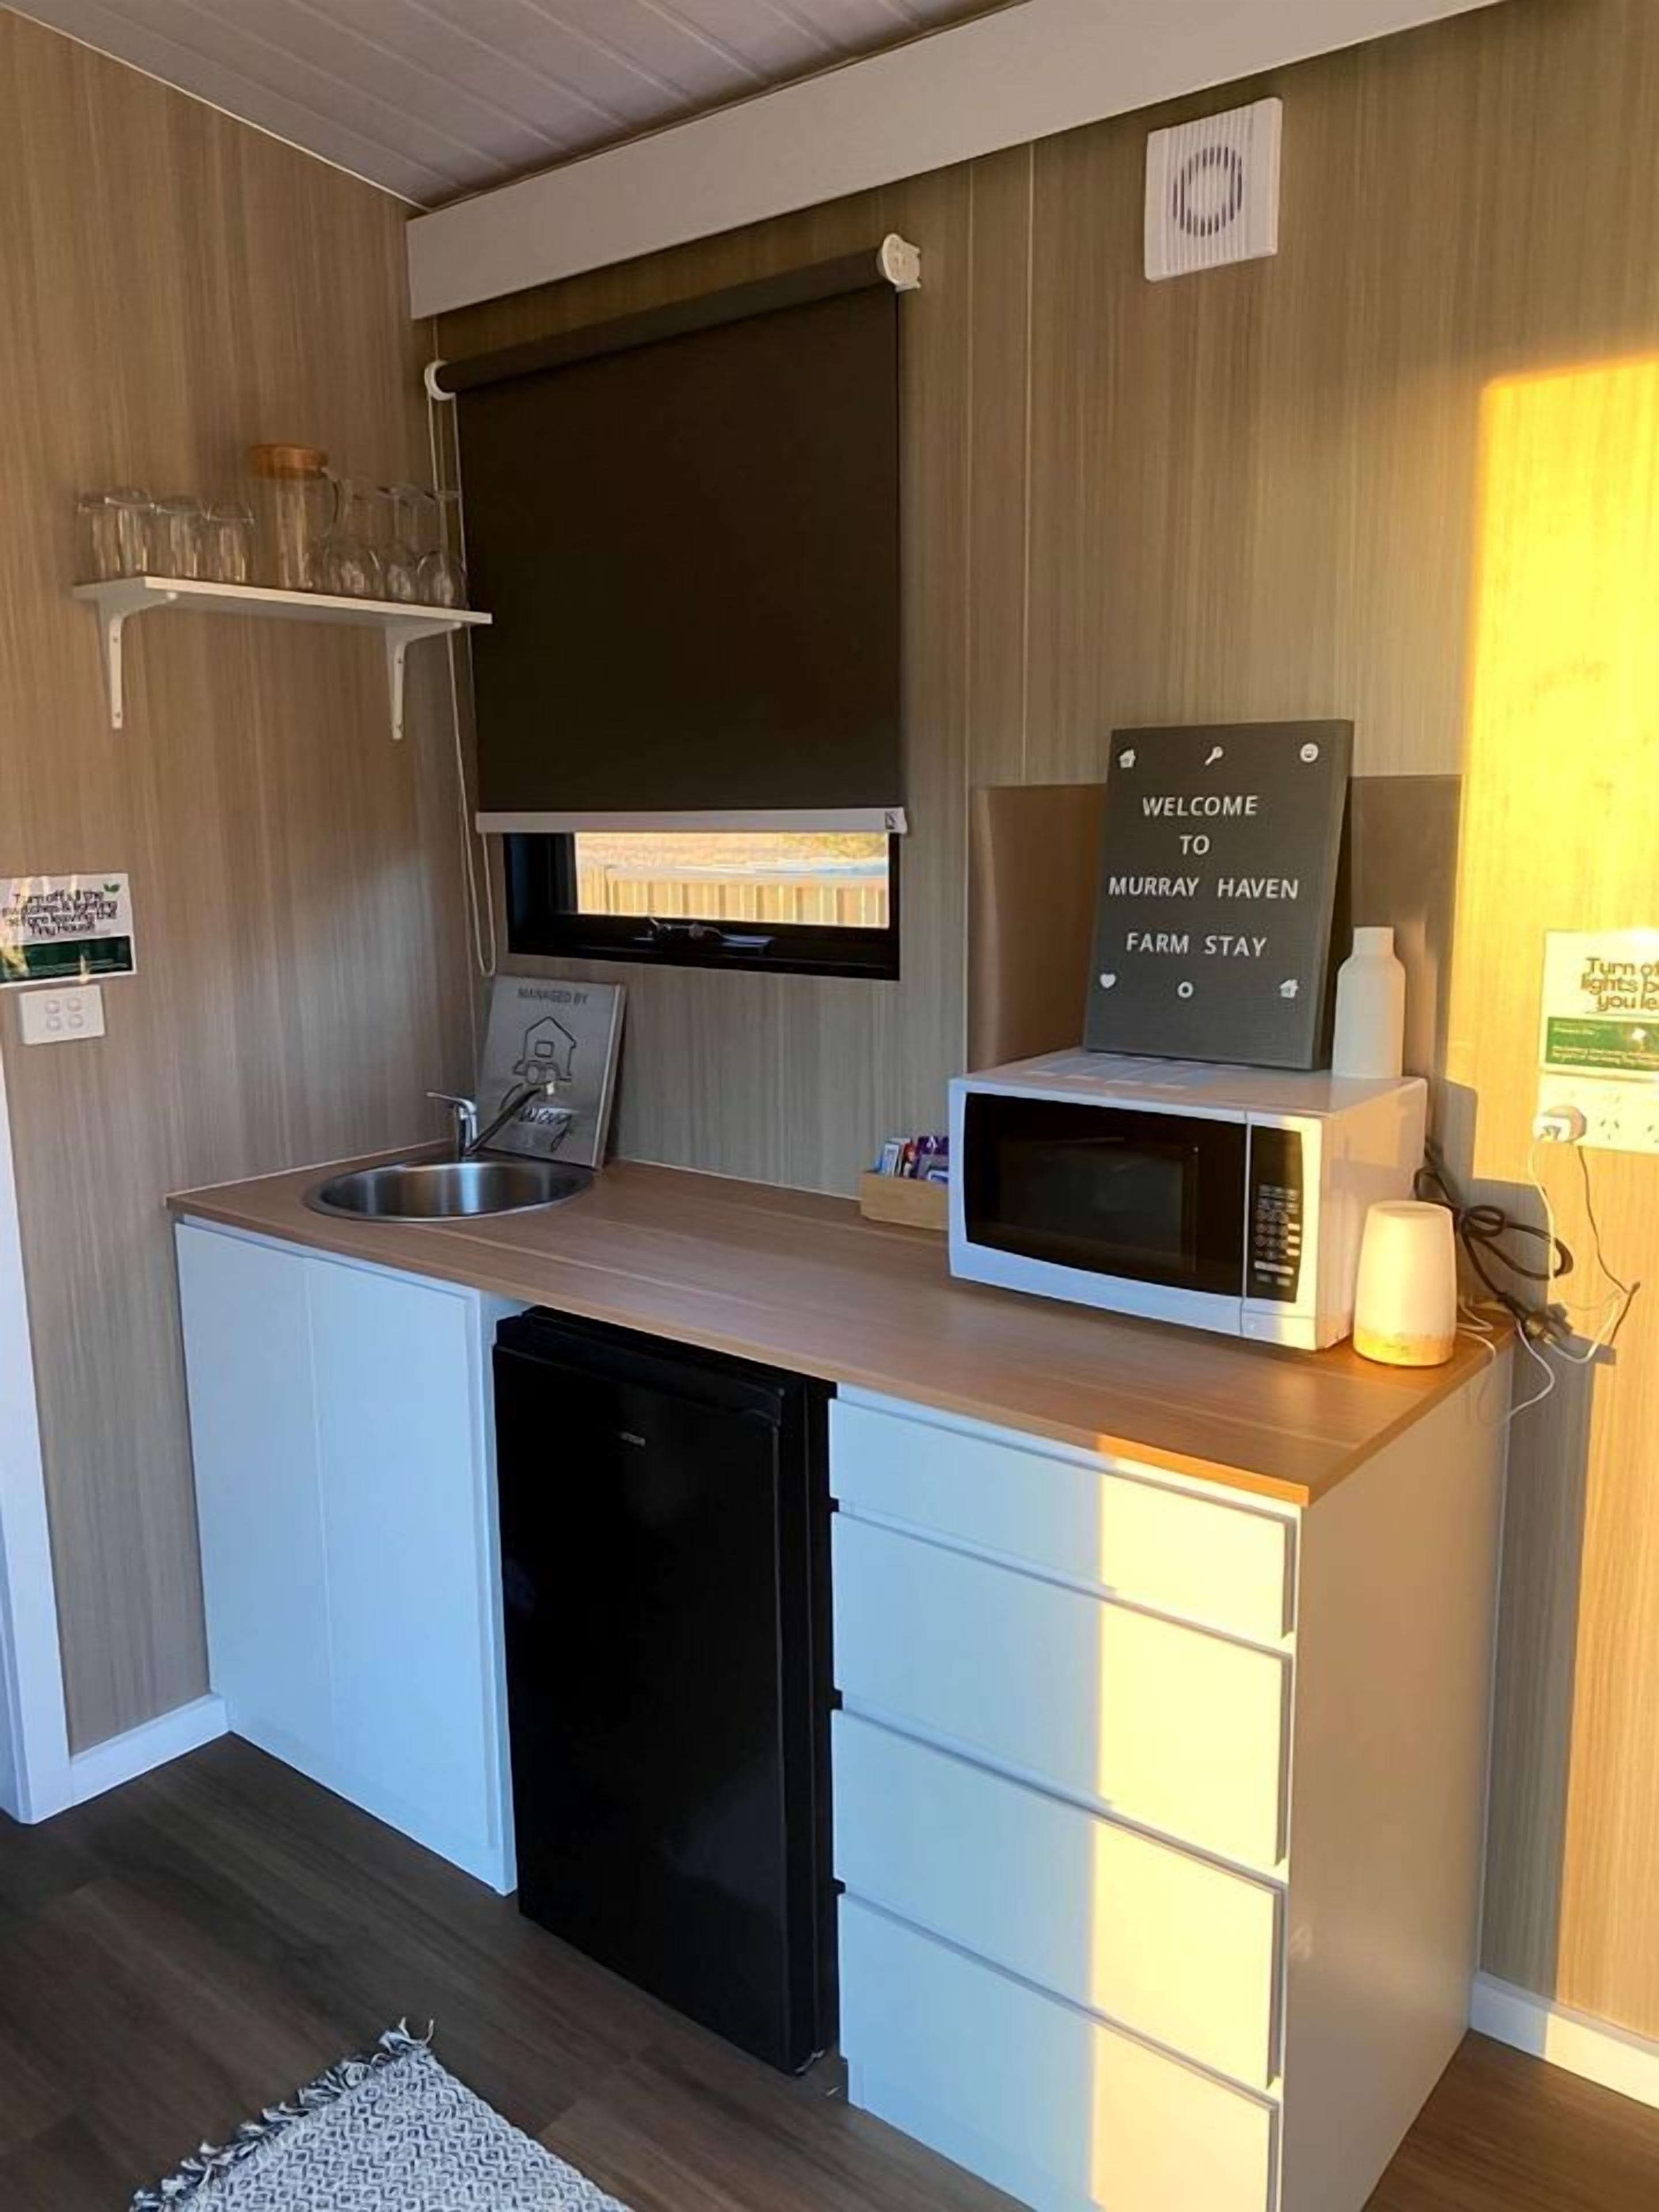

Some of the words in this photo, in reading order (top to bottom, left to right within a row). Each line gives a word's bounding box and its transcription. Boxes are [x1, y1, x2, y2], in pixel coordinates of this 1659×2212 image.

[1143, 796, 1259, 816] WELCOME
[1180, 835, 1210, 855] TO
[1108, 877, 1199, 897] MURRAY
[1217, 877, 1298, 899] HAVEN
[1126, 932, 1190, 953] FARM
[1204, 935, 1267, 957] STAY
[1585, 956, 1635, 976] Turn
[1581, 973, 1638, 995] lights
[518, 988, 571, 1003] MANAGED
[1597, 995, 1636, 1012] you
